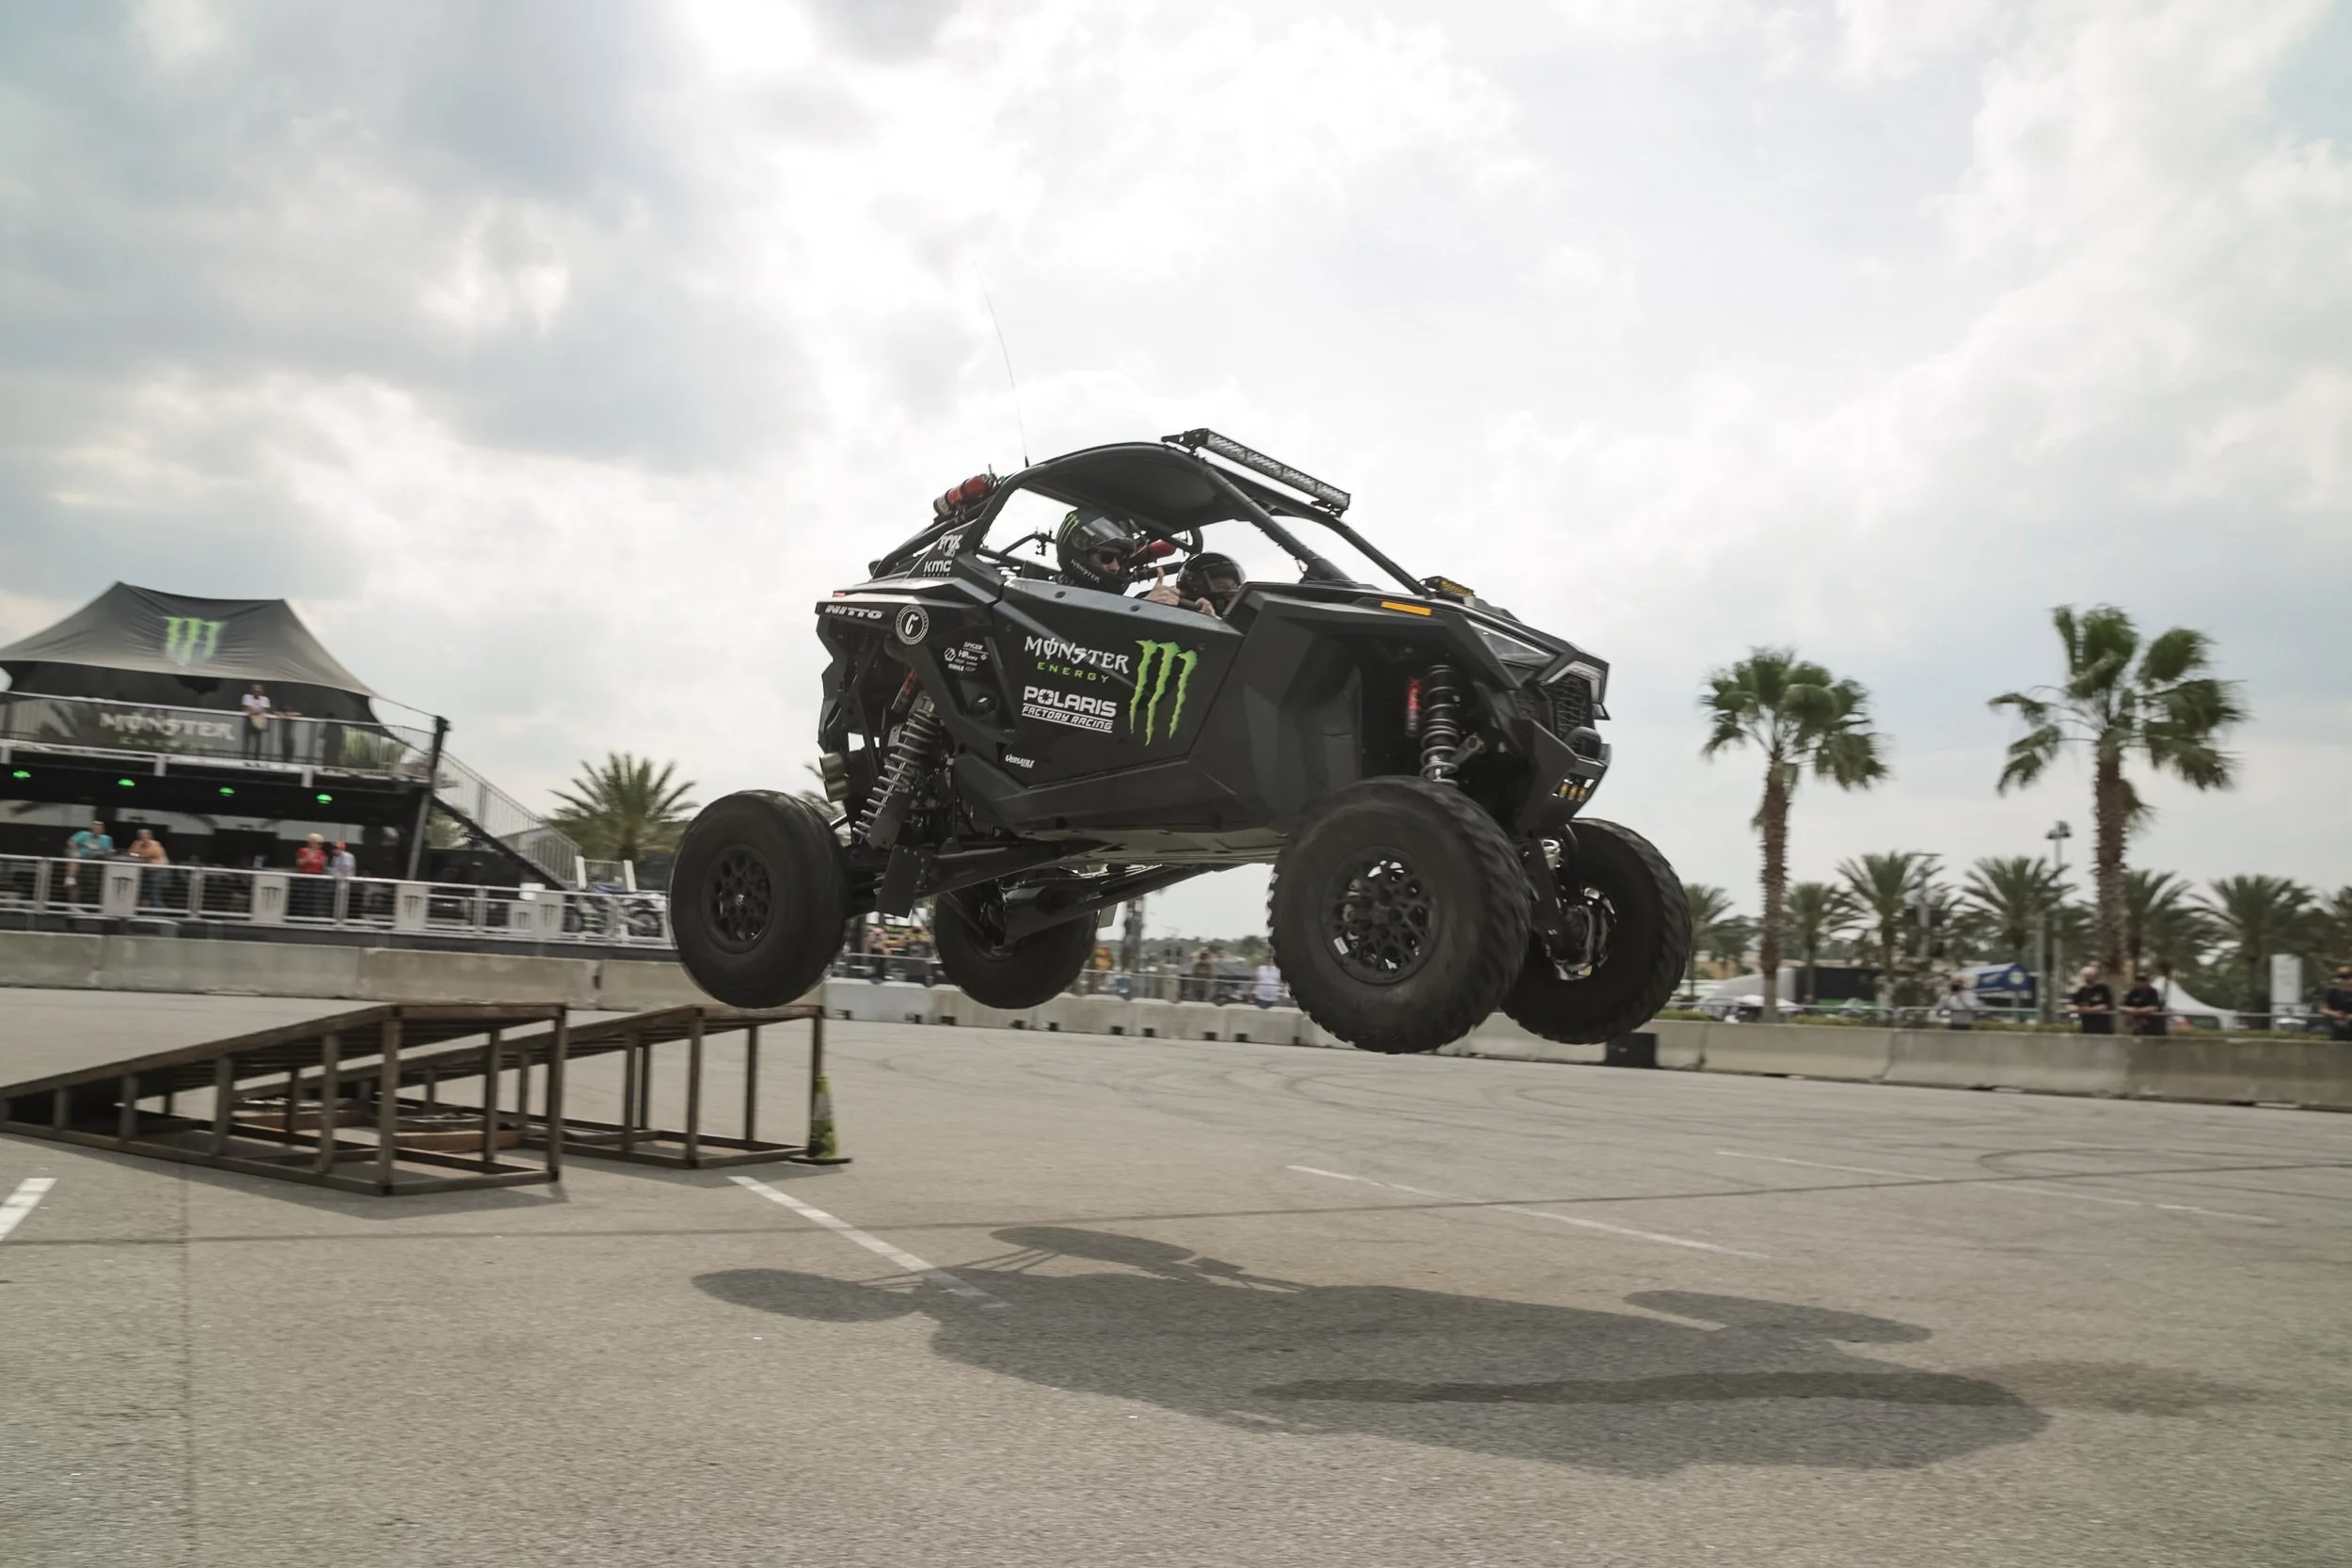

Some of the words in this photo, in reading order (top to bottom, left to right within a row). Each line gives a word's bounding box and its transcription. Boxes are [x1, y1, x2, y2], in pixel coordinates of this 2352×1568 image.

[937, 534, 962, 558] FOX
[923, 560, 952, 573] KMC
[825, 604, 883, 619] NITTO
[1024, 636, 1129, 674] MONSTER
[1037, 661, 1110, 684] ENERGY
[1023, 685, 1118, 718] POLARIS
[1022, 706, 1071, 722] FACTORY
[1071, 716, 1114, 731] RACING
